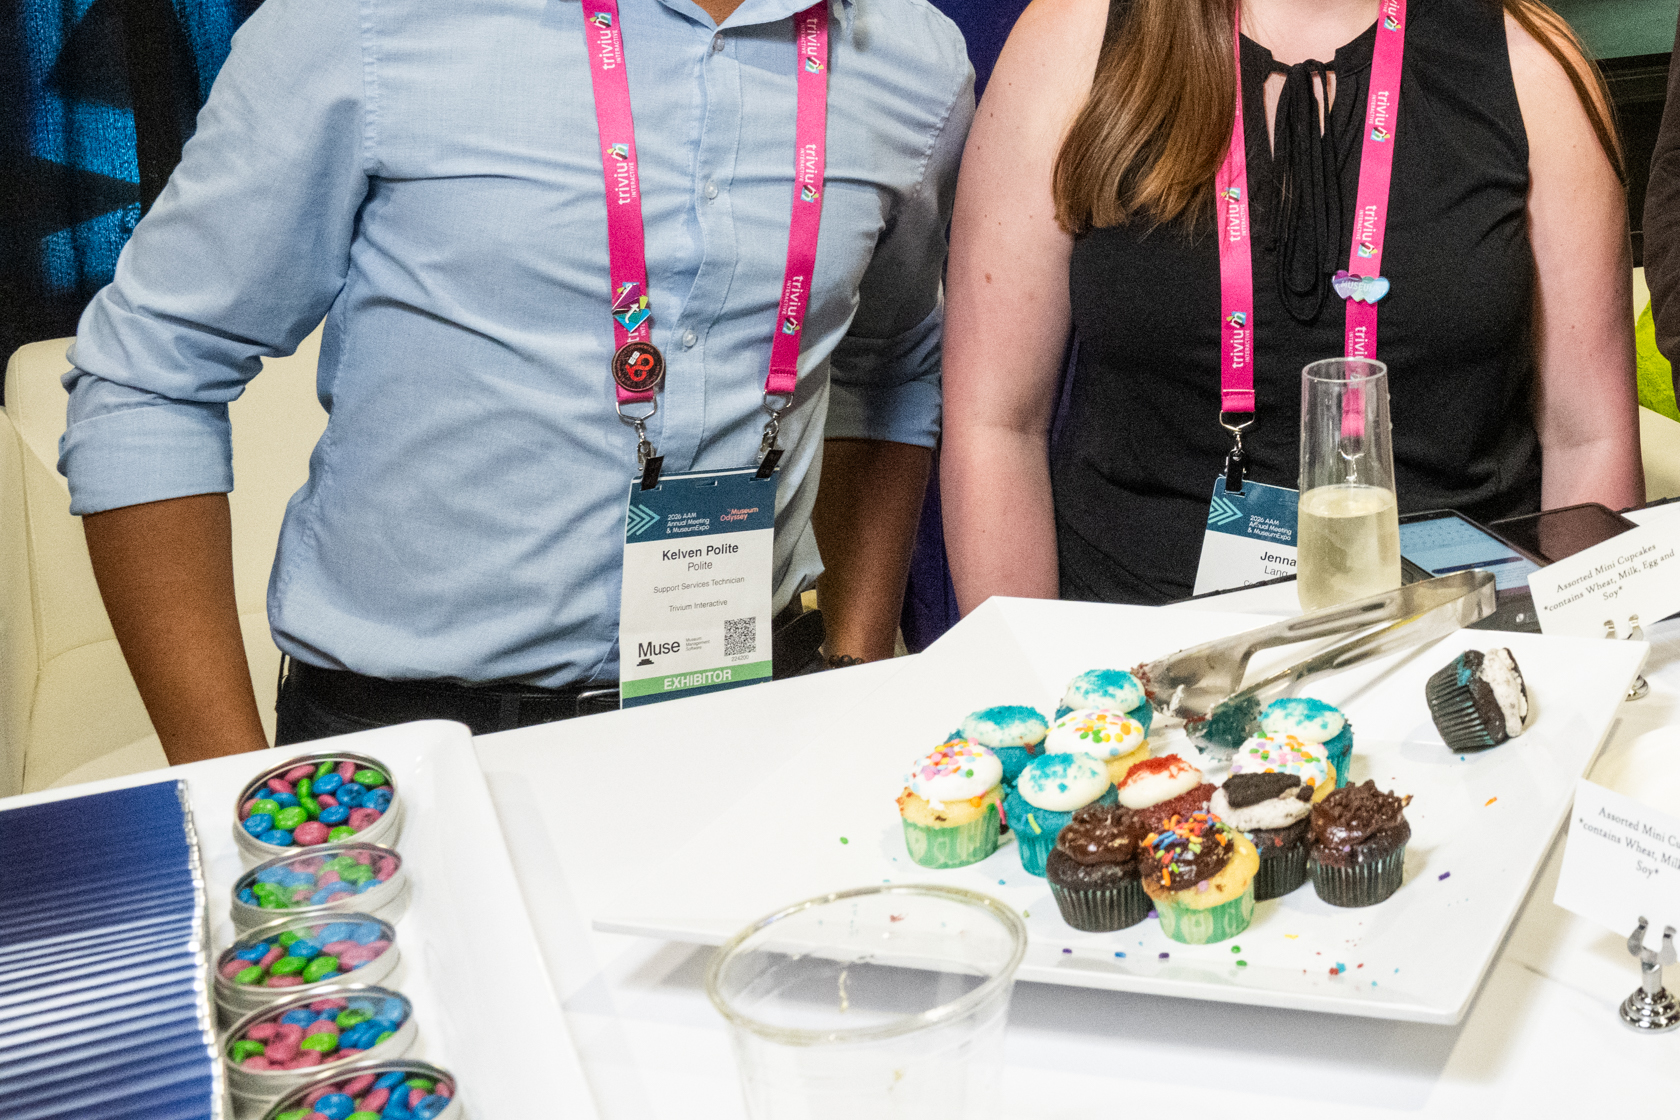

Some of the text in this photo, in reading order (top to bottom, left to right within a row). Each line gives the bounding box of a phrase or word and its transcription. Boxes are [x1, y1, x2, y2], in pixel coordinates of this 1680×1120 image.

[594, 13, 616, 70] trivium
[805, 18, 821, 73] trivium
[1372, 91, 1390, 141] trivium
[611, 144, 630, 205] trivium
[803, 144, 819, 202] trivium
[1359, 205, 1378, 257] trivium
[784, 275, 804, 334] trivium
[1230, 313, 1246, 368] trivium
[672, 525, 710, 533] MuseumExpo
[720, 513, 748, 522] Odyssey
[1269, 525, 1292, 535] Meeting
[1253, 527, 1291, 540] MuseumExpo
[662, 543, 739, 561] Kelven Polite
[1260, 551, 1297, 567] Jenna
[687, 560, 713, 571] Polite
[1556, 543, 1656, 593] Assorted Mini Cupcakes
[1586, 576, 1617, 596] Wheat,
[1618, 566, 1642, 582] Milk,
[1642, 559, 1659, 573] Egg
[1660, 548, 1675, 562] and
[653, 576, 745, 594] Support Services Technician
[669, 599, 728, 612] Trivium Interactive
[638, 641, 680, 658] Muse
[664, 669, 732, 690] EXHIBITOR
[1598, 806, 1640, 832] Assorted
[1641, 823, 1665, 843] Mini
[1625, 836, 1658, 862] Wheat,
